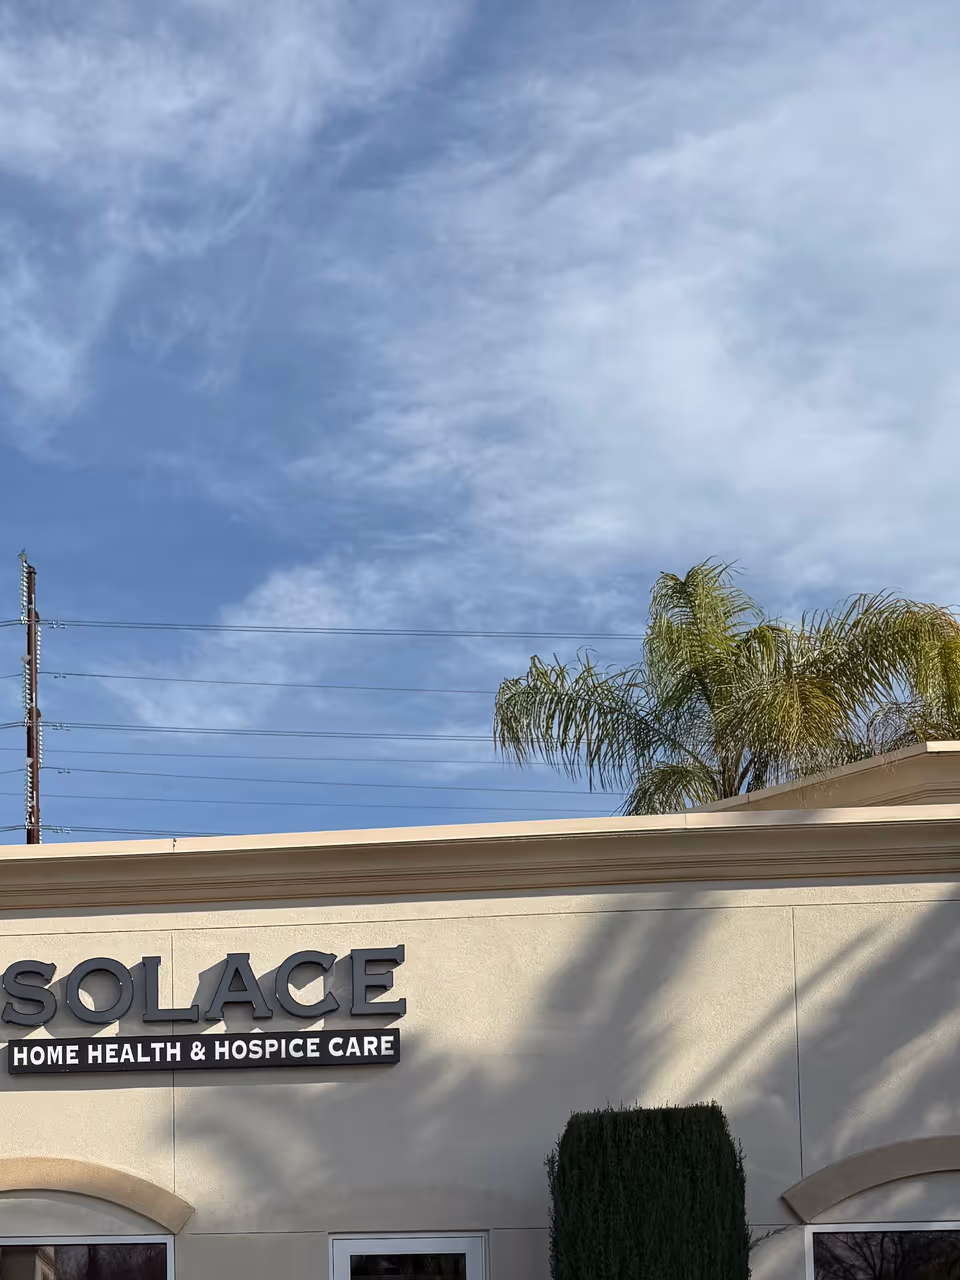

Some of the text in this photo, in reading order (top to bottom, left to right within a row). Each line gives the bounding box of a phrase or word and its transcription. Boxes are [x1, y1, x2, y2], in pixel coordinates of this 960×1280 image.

[1, 944, 407, 1027] SOLACE
[13, 1036, 395, 1067] HOME HEALTH & HOSPICE CARE
